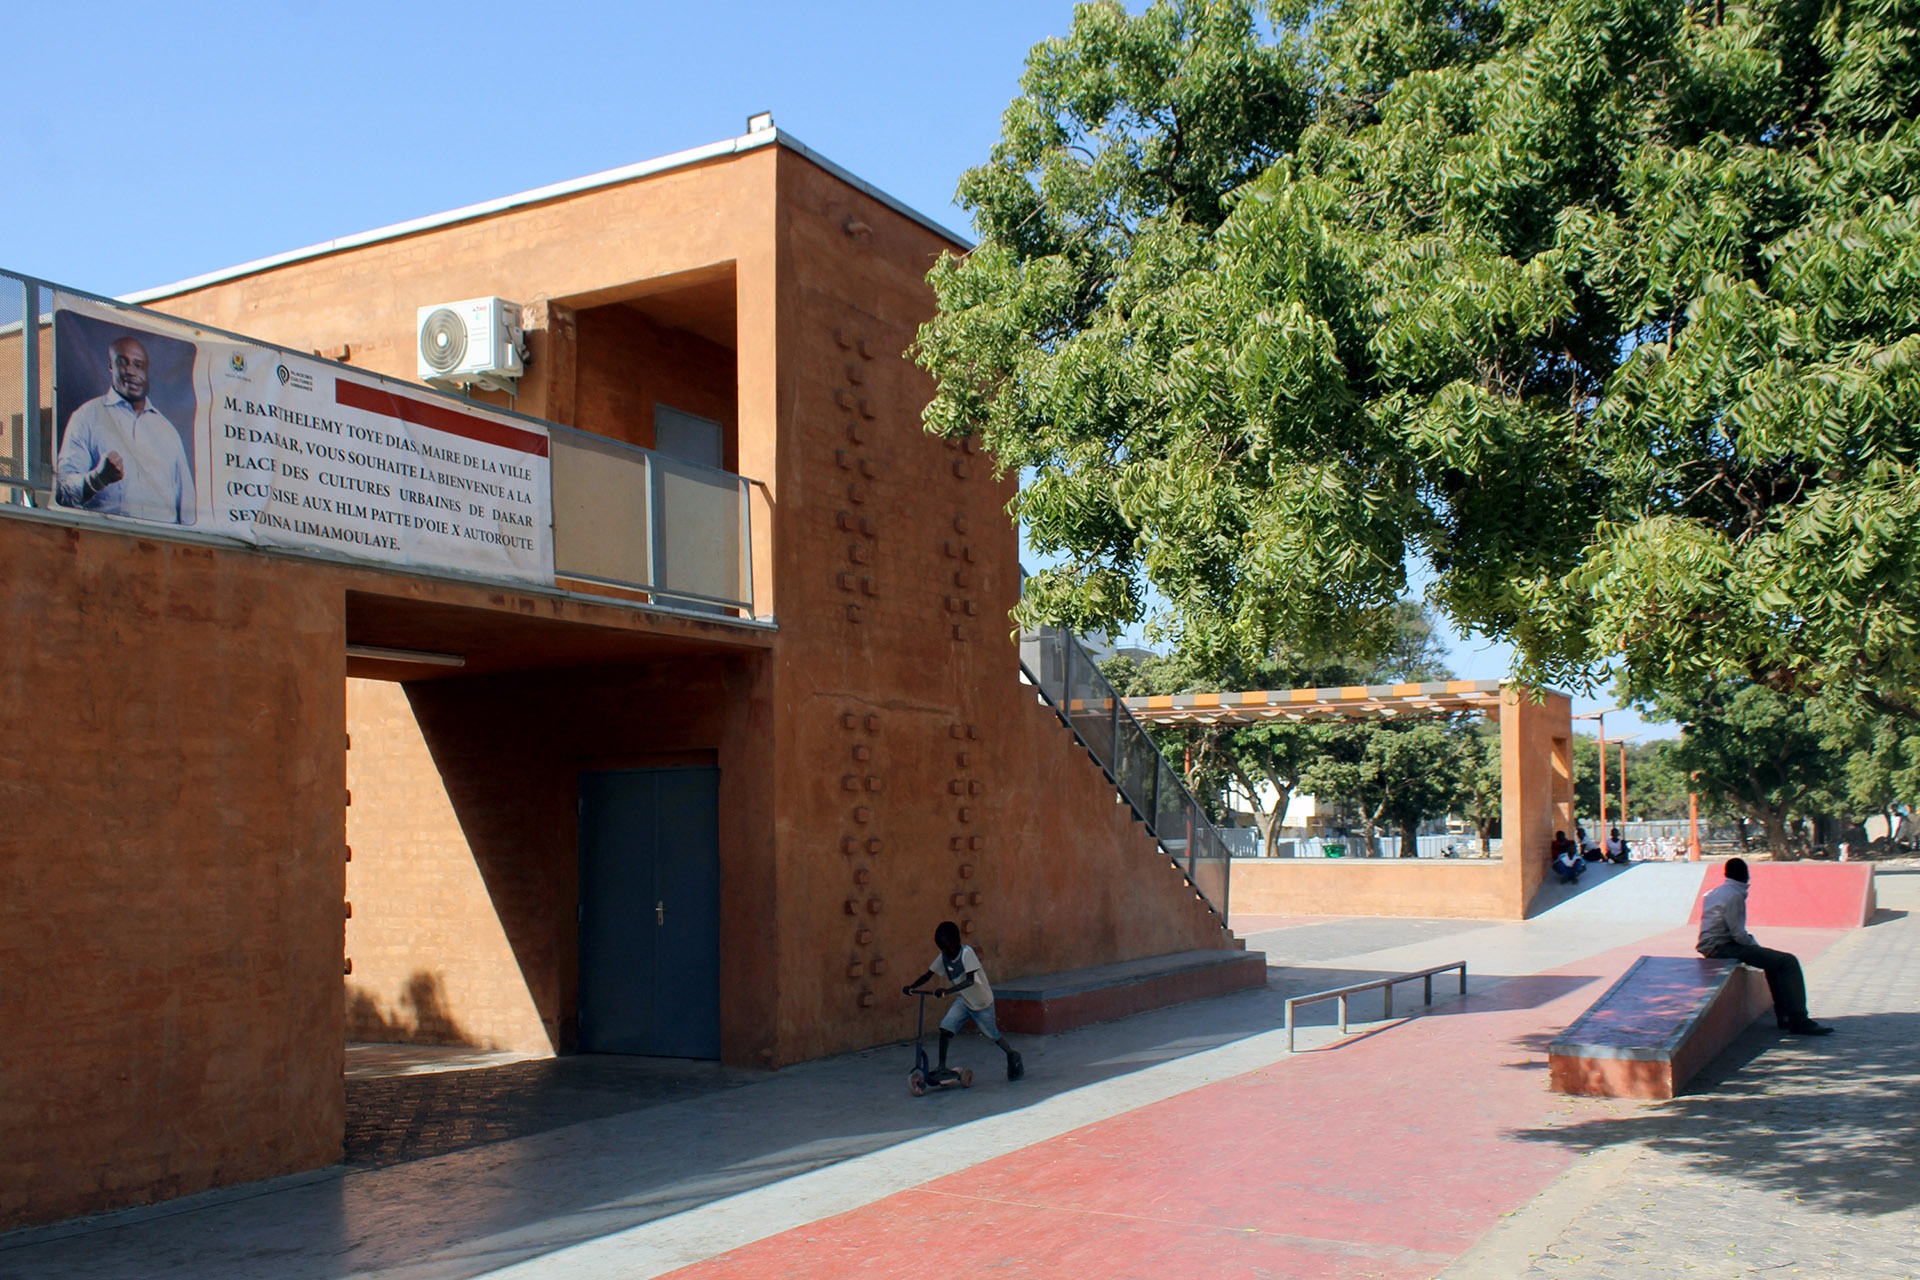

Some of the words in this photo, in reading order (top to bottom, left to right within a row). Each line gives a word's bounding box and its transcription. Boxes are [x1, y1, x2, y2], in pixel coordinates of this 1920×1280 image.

[224, 396, 242, 412] M.
[245, 400, 343, 435] BARTHELEMY
[346, 424, 383, 445] TOYE
[386, 434, 419, 456] DIAS,
[421, 443, 462, 465] MAIRE
[463, 454, 479, 469] DE
[482, 459, 497, 473] LA
[499, 462, 532, 481] VILLE
[224, 424, 246, 441] DE
[306, 441, 345, 462] VOUS
[348, 451, 418, 478] SOUHAITE
[420, 467, 436, 482] LA
[438, 472, 505, 499] BIENVENUE
[506, 489, 515, 501] A
[517, 490, 532, 504] LA
[225, 453, 277, 472] PLACE
[282, 463, 309, 480] DES
[318, 471, 391, 497] CULTURES
[399, 487, 462, 513] URBAINES
[469, 503, 485, 518] DE
[492, 508, 533, 527] DAKAR
[272, 487, 299, 506] SISE
[302, 495, 333, 513] AUX
[335, 501, 368, 519] HLM
[371, 507, 412, 528] PATTE
[451, 524, 461, 537] X
[464, 527, 534, 550] AUTOROUTE
[229, 509, 292, 531] SEYDINA
[294, 519, 401, 550] LIMAMOULAYE.
